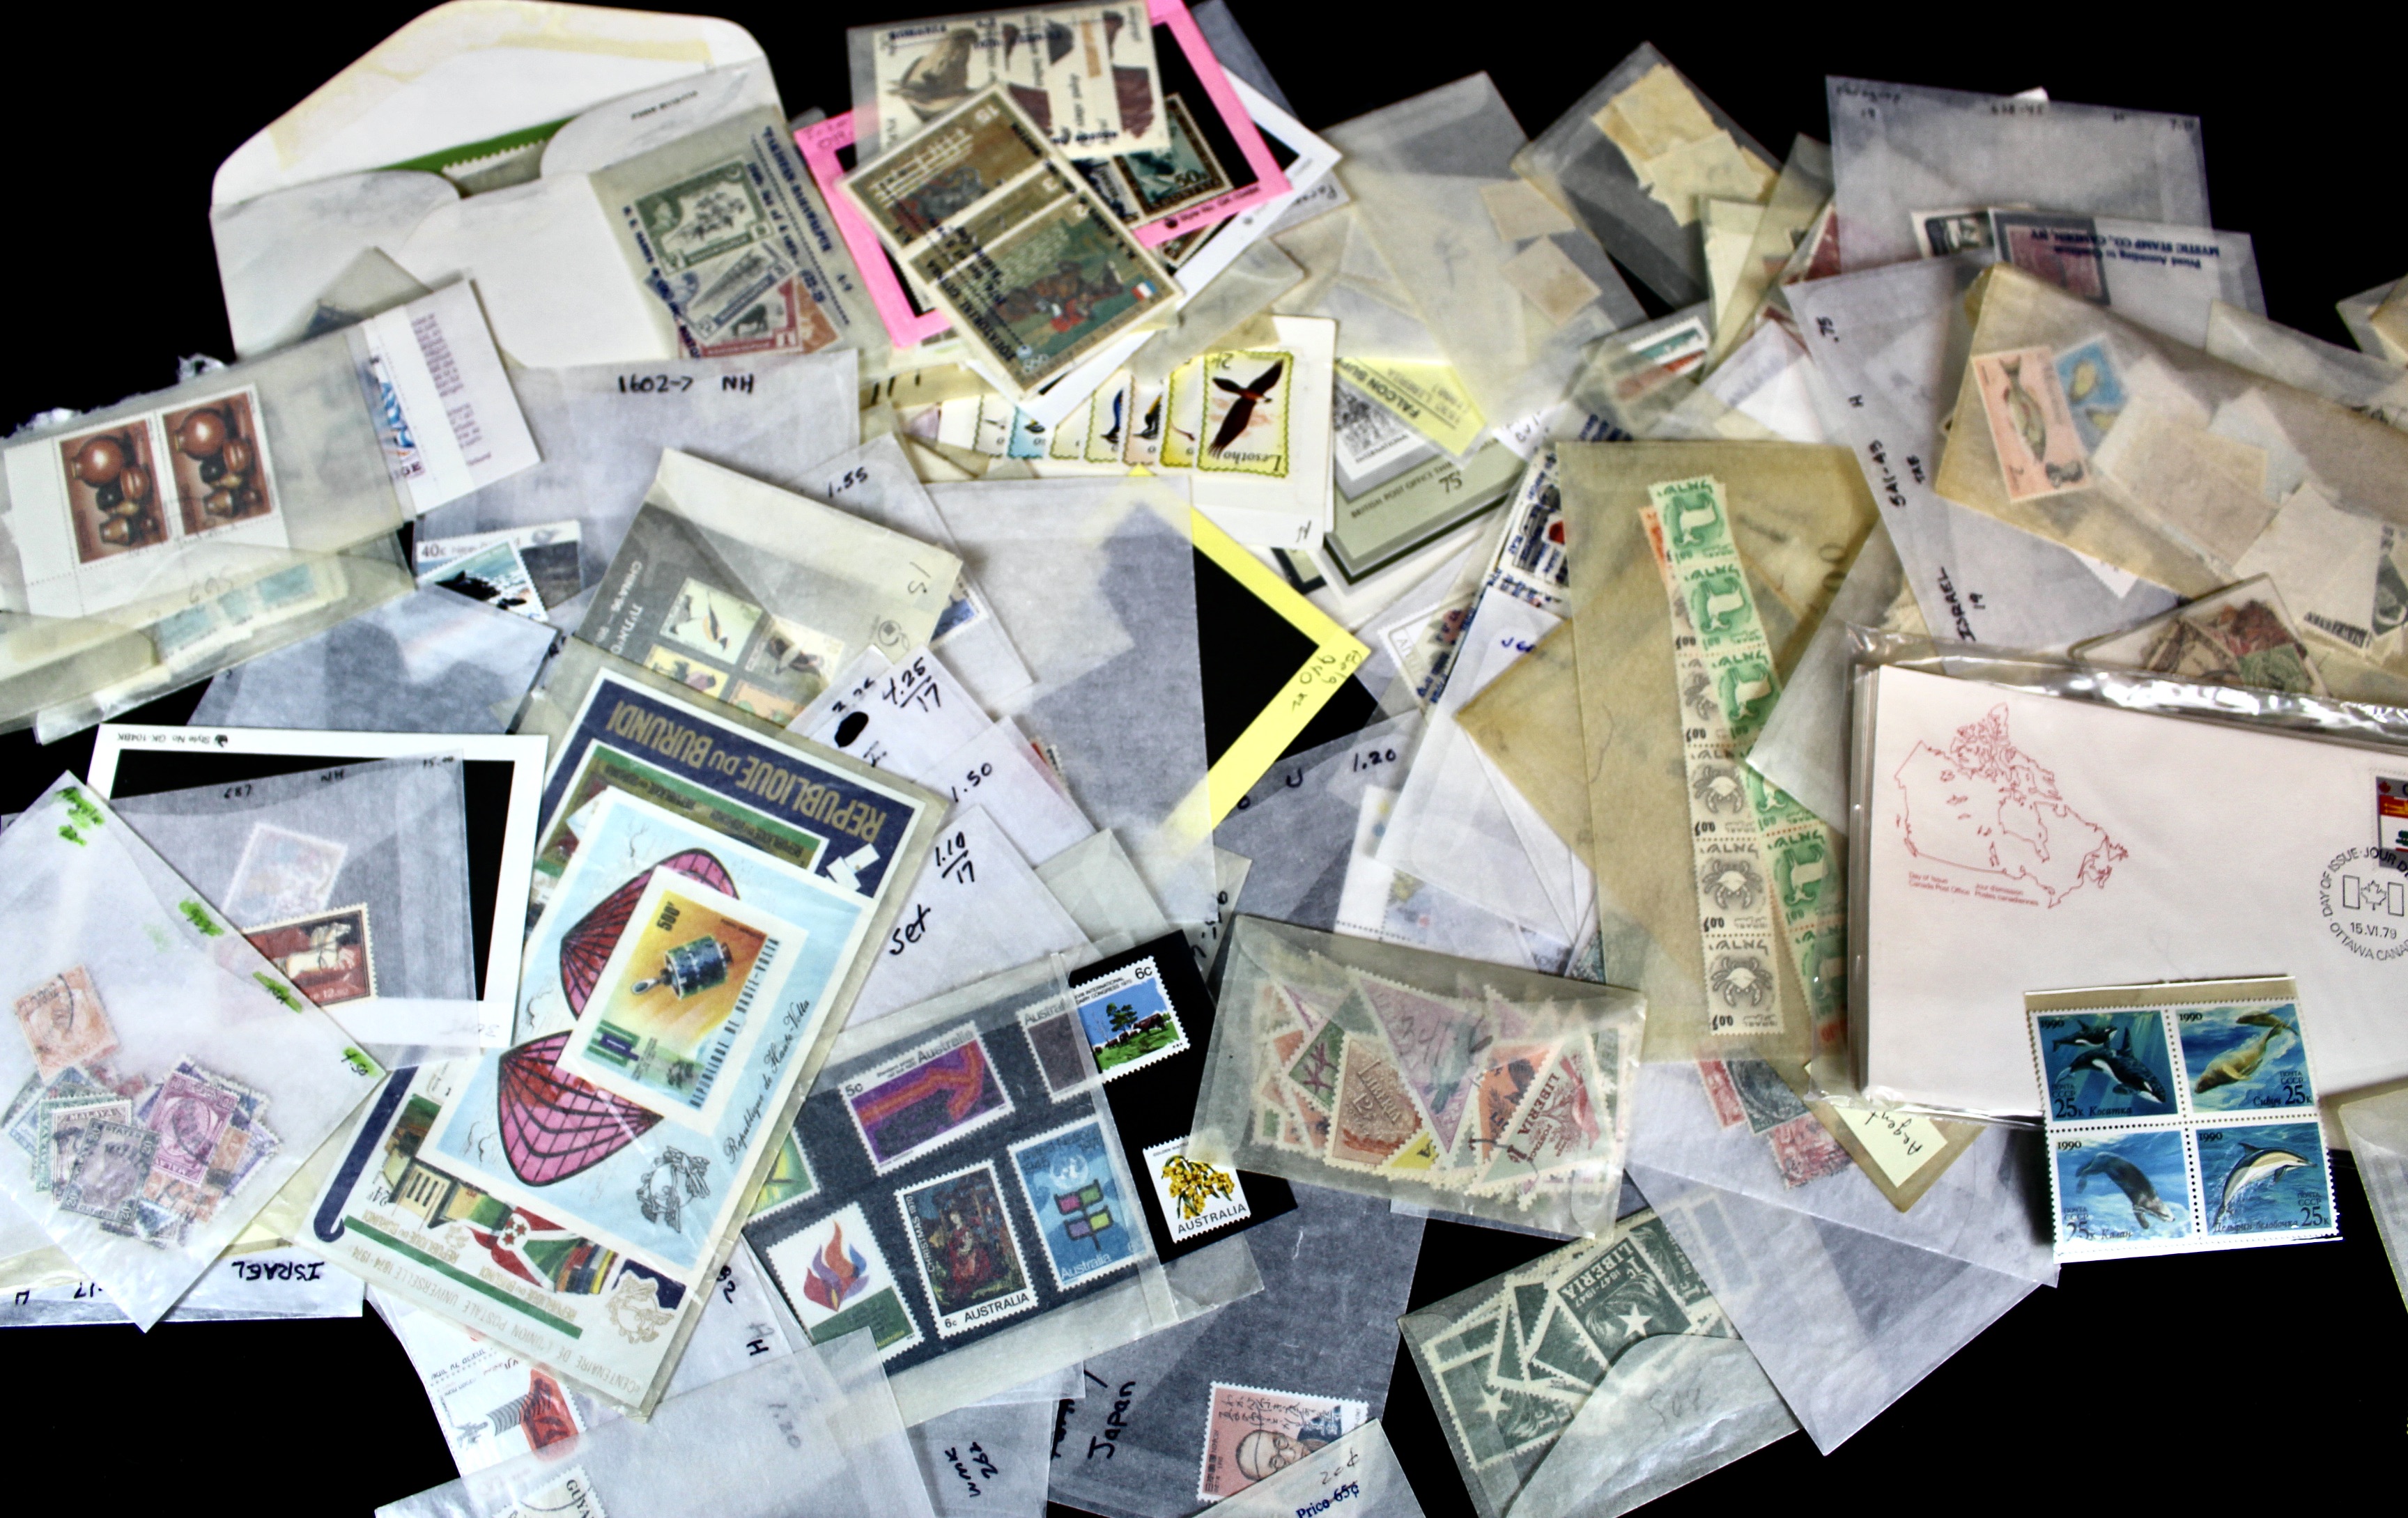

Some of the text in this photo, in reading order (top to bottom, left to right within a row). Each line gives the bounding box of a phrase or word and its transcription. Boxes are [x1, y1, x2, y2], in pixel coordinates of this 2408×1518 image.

[721, 373, 755, 395] NH
[605, 699, 713, 767] BURUNDI
[708, 749, 742, 775] DU
[1349, 743, 1398, 773] 1.20
[2327, 847, 2359, 874] ISSUE
[2329, 921, 2375, 960] OTTAWA
[2349, 921, 2397, 942] 15.VI.79
[1134, 964, 1153, 979] 6c
[846, 1080, 863, 1094] 5c
[1177, 1202, 1247, 1235] AUSTRALIA
[910, 1215, 935, 1273] CHRISTMAS
[231, 1260, 325, 1282] ISRAEL
[1060, 1253, 1111, 1280] Australia
[1560, 1241, 1633, 1302] LIBERIA
[964, 1292, 1031, 1324] AUSTRALIA
[746, 1339, 769, 1357] H
[1088, 1380, 1136, 1460] Japan
